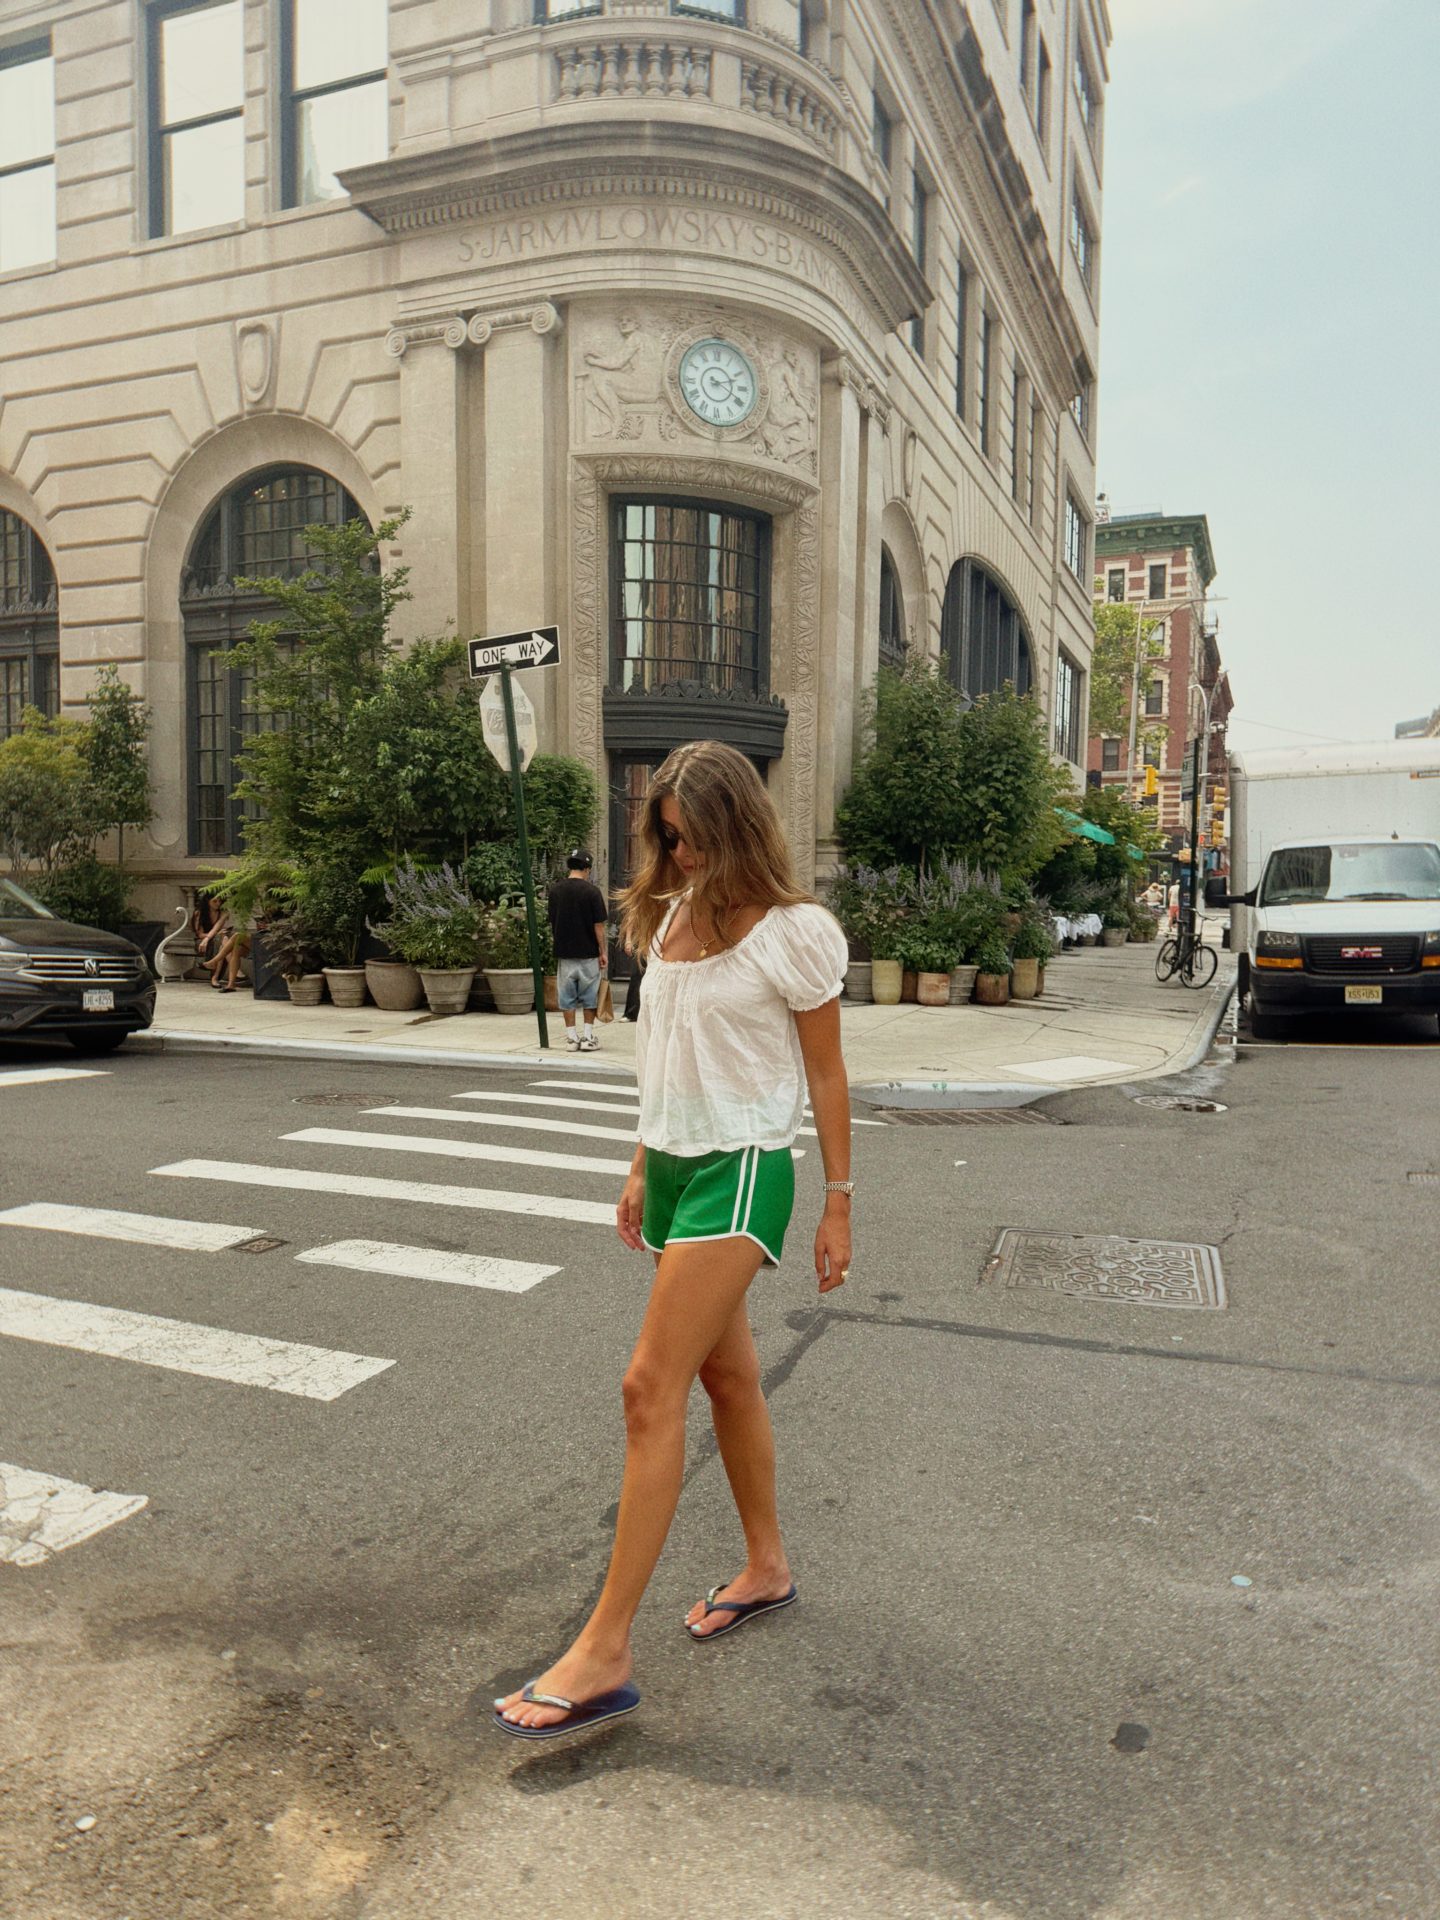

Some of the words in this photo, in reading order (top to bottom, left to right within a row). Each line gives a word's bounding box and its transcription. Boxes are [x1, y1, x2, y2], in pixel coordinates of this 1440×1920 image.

[776, 231, 834, 294] BANK
[482, 647, 506, 664] ONE
[518, 641, 545, 658] WAY
[1341, 947, 1383, 958] GMC
